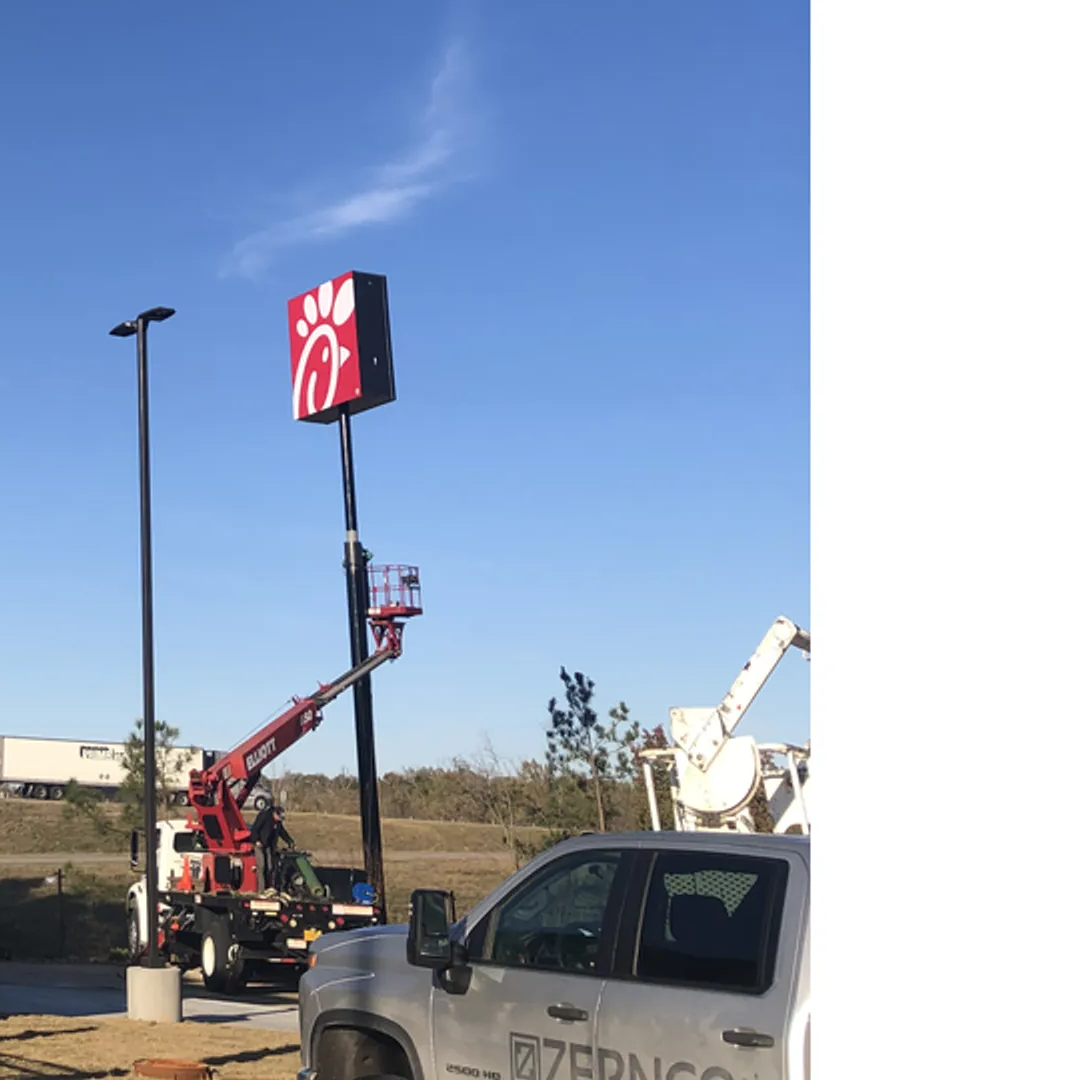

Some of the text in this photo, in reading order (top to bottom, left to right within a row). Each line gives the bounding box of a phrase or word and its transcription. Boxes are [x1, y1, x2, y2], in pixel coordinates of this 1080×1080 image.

[245, 737, 277, 772] ELLIOTT
[446, 1063, 480, 1079] 2500
[542, 1037, 734, 1080] ZER
